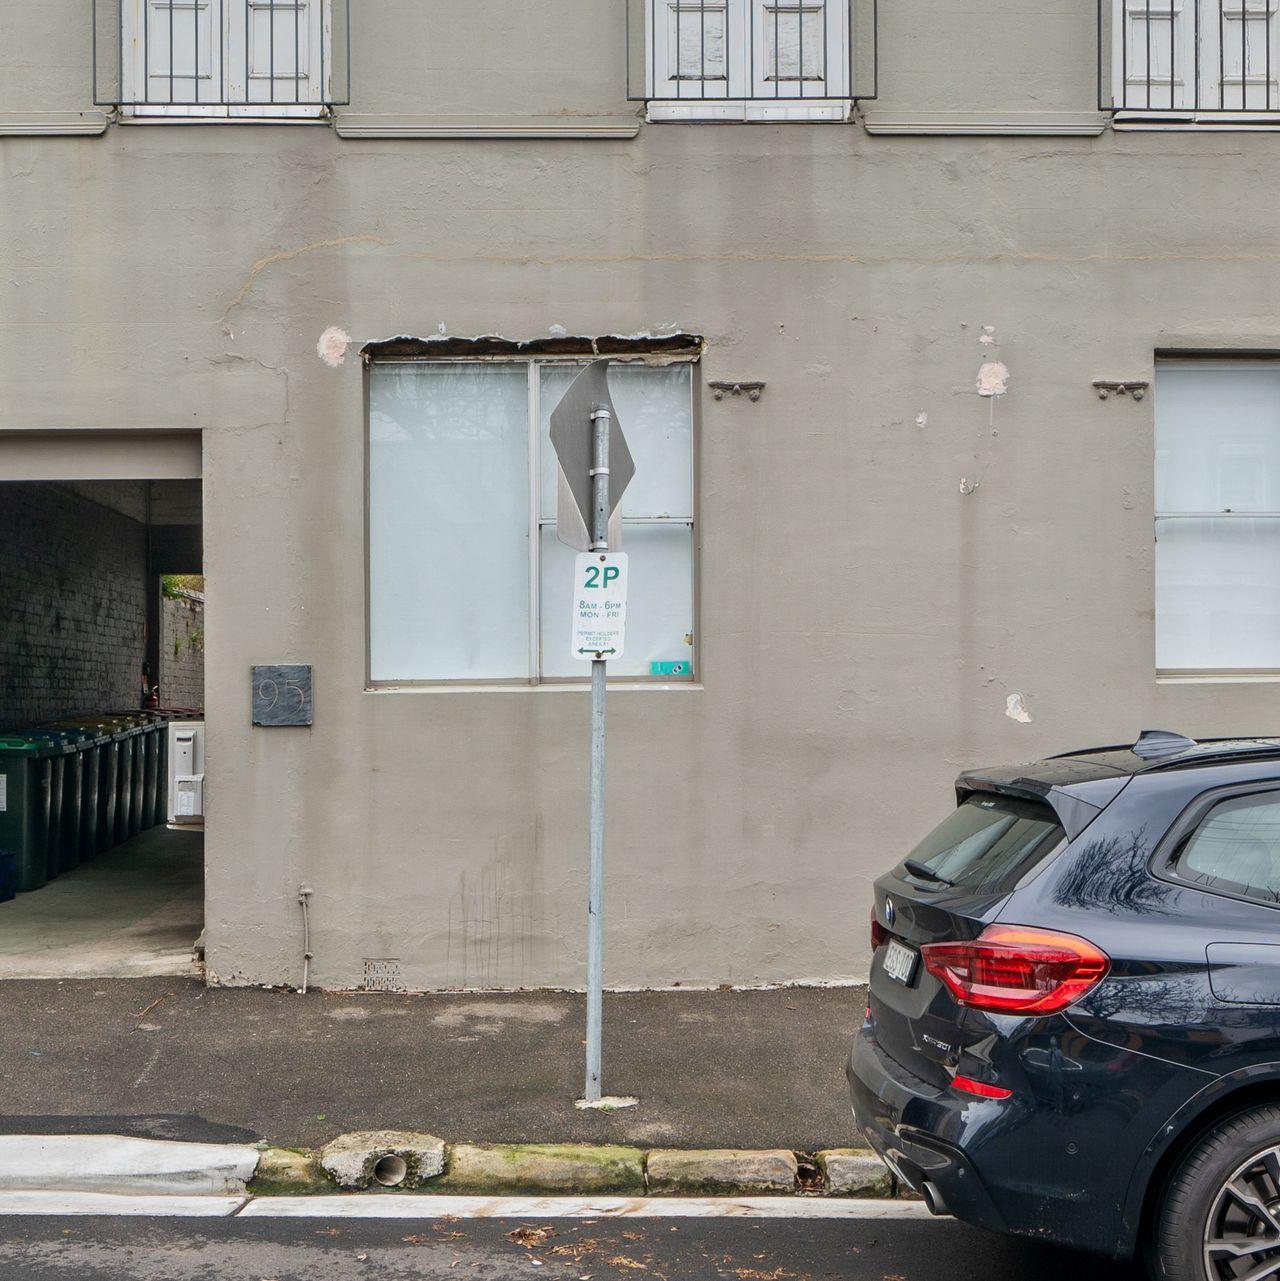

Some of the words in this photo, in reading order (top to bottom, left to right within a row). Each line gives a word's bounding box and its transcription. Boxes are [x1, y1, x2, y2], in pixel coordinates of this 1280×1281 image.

[584, 566, 620, 589] 2P
[579, 600, 597, 609] 8AM
[604, 600, 621, 610] 6PM
[259, 679, 304, 719] 95
